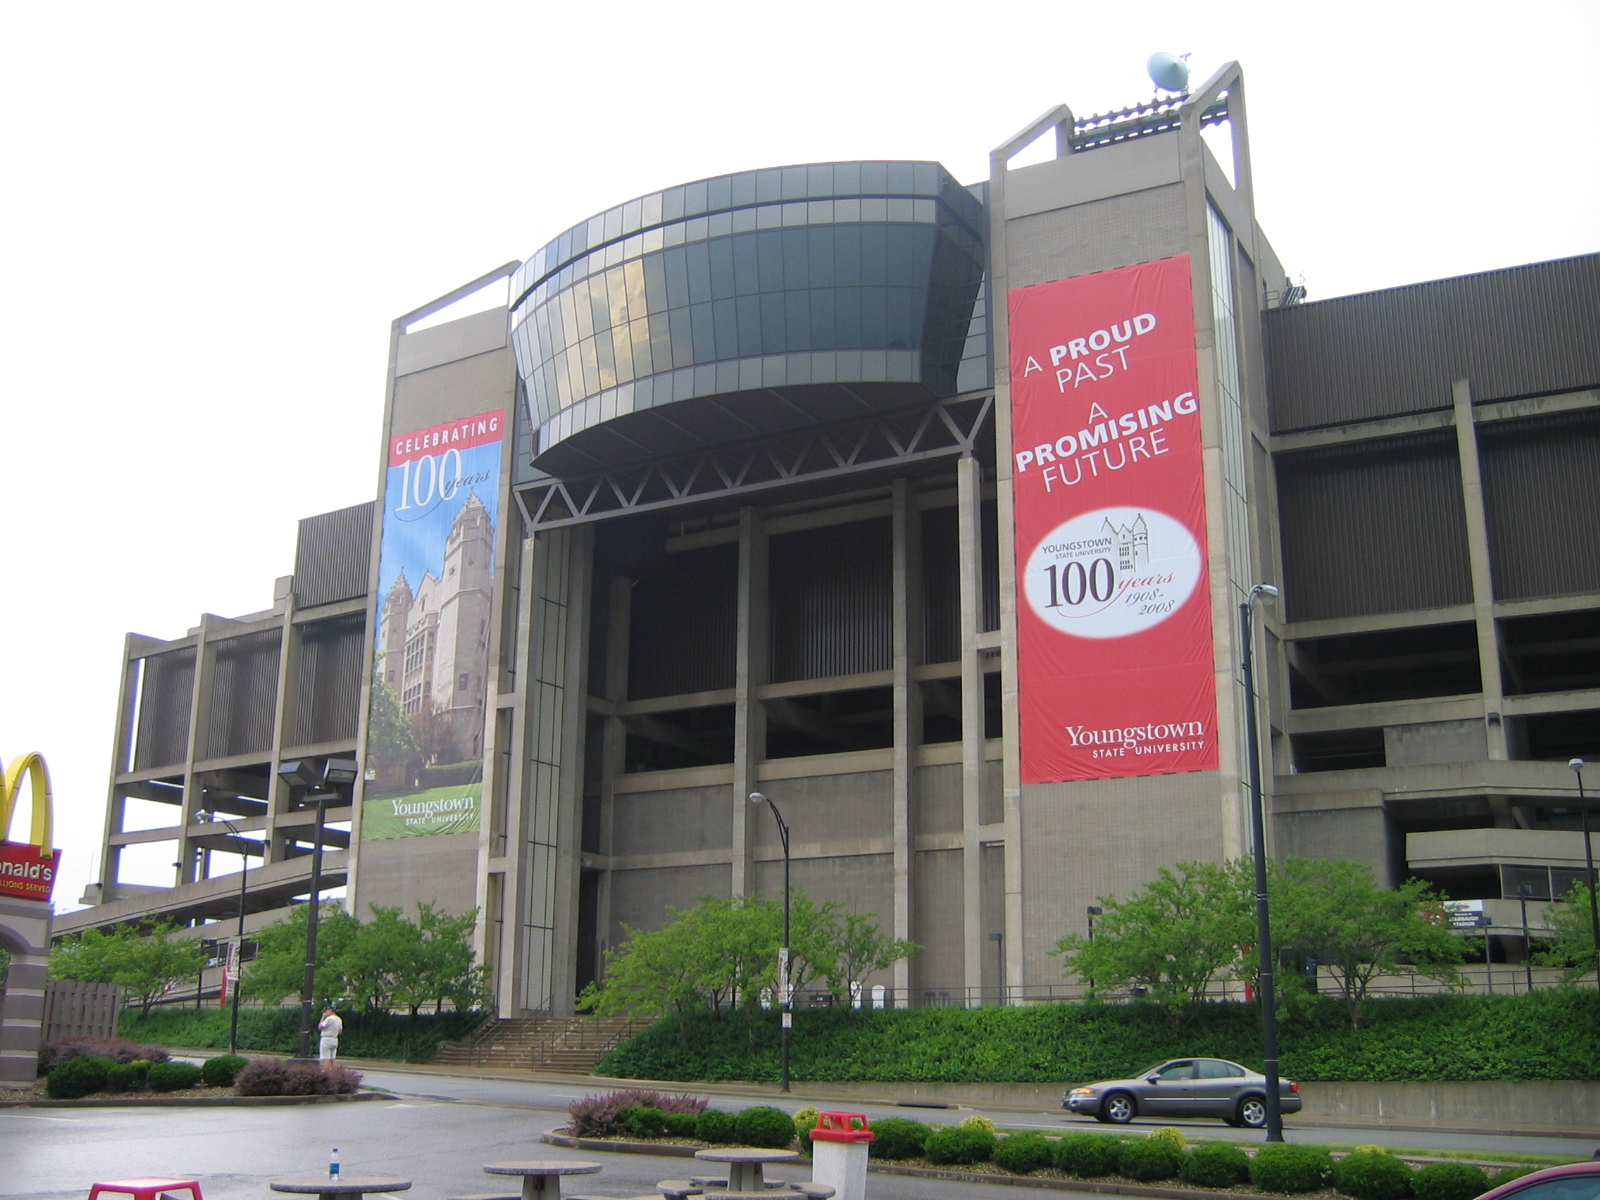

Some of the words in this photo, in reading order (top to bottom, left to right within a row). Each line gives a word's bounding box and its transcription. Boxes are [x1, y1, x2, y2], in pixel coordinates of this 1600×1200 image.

[1024, 356, 1043, 377] A
[1049, 313, 1156, 367] PROUD
[1056, 345, 1130, 393] PAST
[1088, 402, 1108, 424] A
[395, 417, 498, 456] CELEBRATING
[1015, 391, 1198, 473] PROMISING
[1042, 428, 1169, 493] FUTURE
[395, 448, 462, 512] 100
[1042, 537, 1112, 554] YOUNGSTOWN
[1055, 552, 1074, 560] STATE
[1075, 547, 1112, 557] UNIVERSITY
[1044, 558, 1115, 608] 100
[1137, 599, 1175, 615] 2008
[1065, 720, 1204, 749] Youngstown
[1092, 748, 1125, 759] STATE
[1135, 740, 1204, 755] UNIVERSITY
[392, 797, 474, 818] Youngstown
[431, 813, 474, 824] UNIVERSITY
[0, 861, 53, 881] nald's
[26, 882, 51, 893] SERVED
